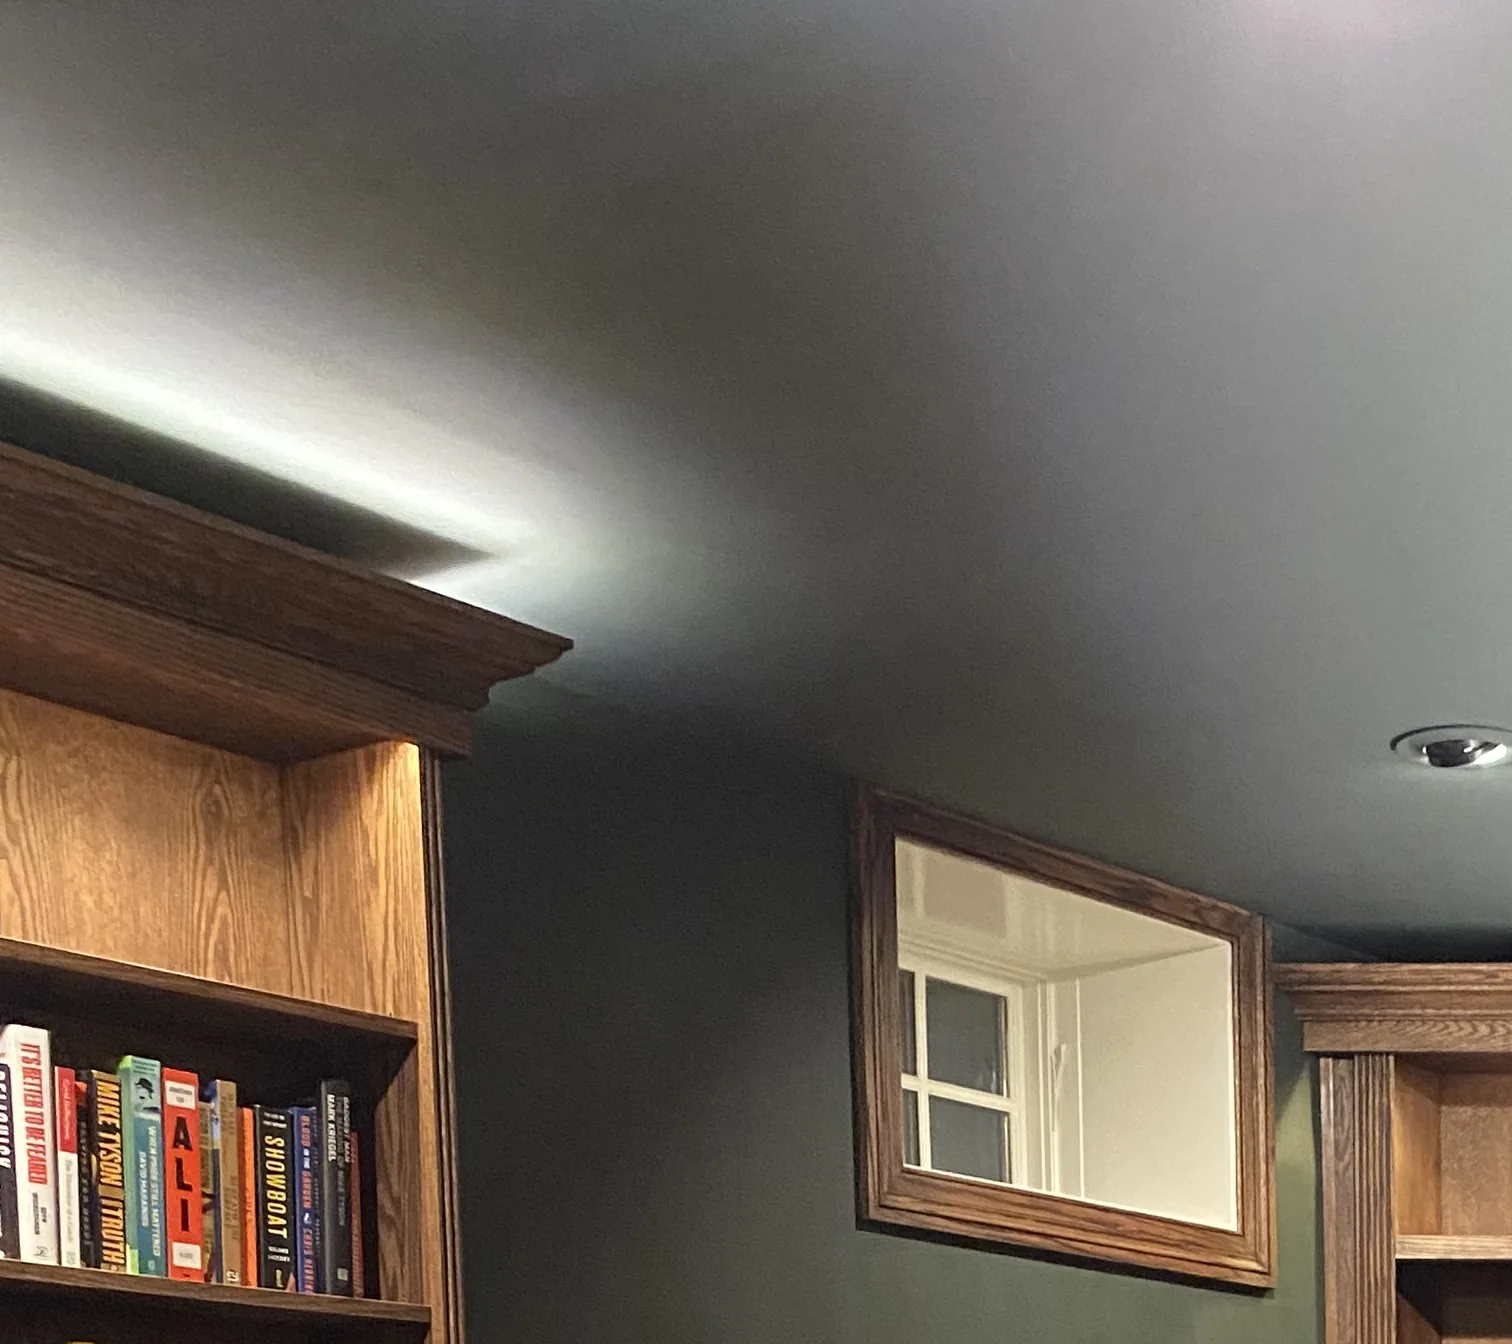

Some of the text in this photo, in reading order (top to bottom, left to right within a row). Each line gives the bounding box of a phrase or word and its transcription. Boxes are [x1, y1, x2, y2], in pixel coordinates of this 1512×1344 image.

[22, 1067, 43, 1108] BETTER
[97, 1080, 120, 1129] MIKE
[25, 1111, 44, 1125] TO
[26, 1127, 45, 1142] BE
[299, 1115, 311, 1147] BLOOD
[327, 1094, 337, 1162] MARK KRIEGEL
[97, 1132, 123, 1187] TYSON
[148, 1126, 157, 1154] WHEN
[26, 1143, 48, 1185] FEARED
[138, 1151, 148, 1179] DAVID
[172, 1116, 194, 1232] ALI
[151, 1182, 159, 1206] STILL
[265, 1135, 287, 1239] SHOWBOAT
[301, 1171, 312, 1209] GARDEN
[101, 1208, 125, 1264] TRUTH
[151, 1208, 160, 1257] MATTERED
